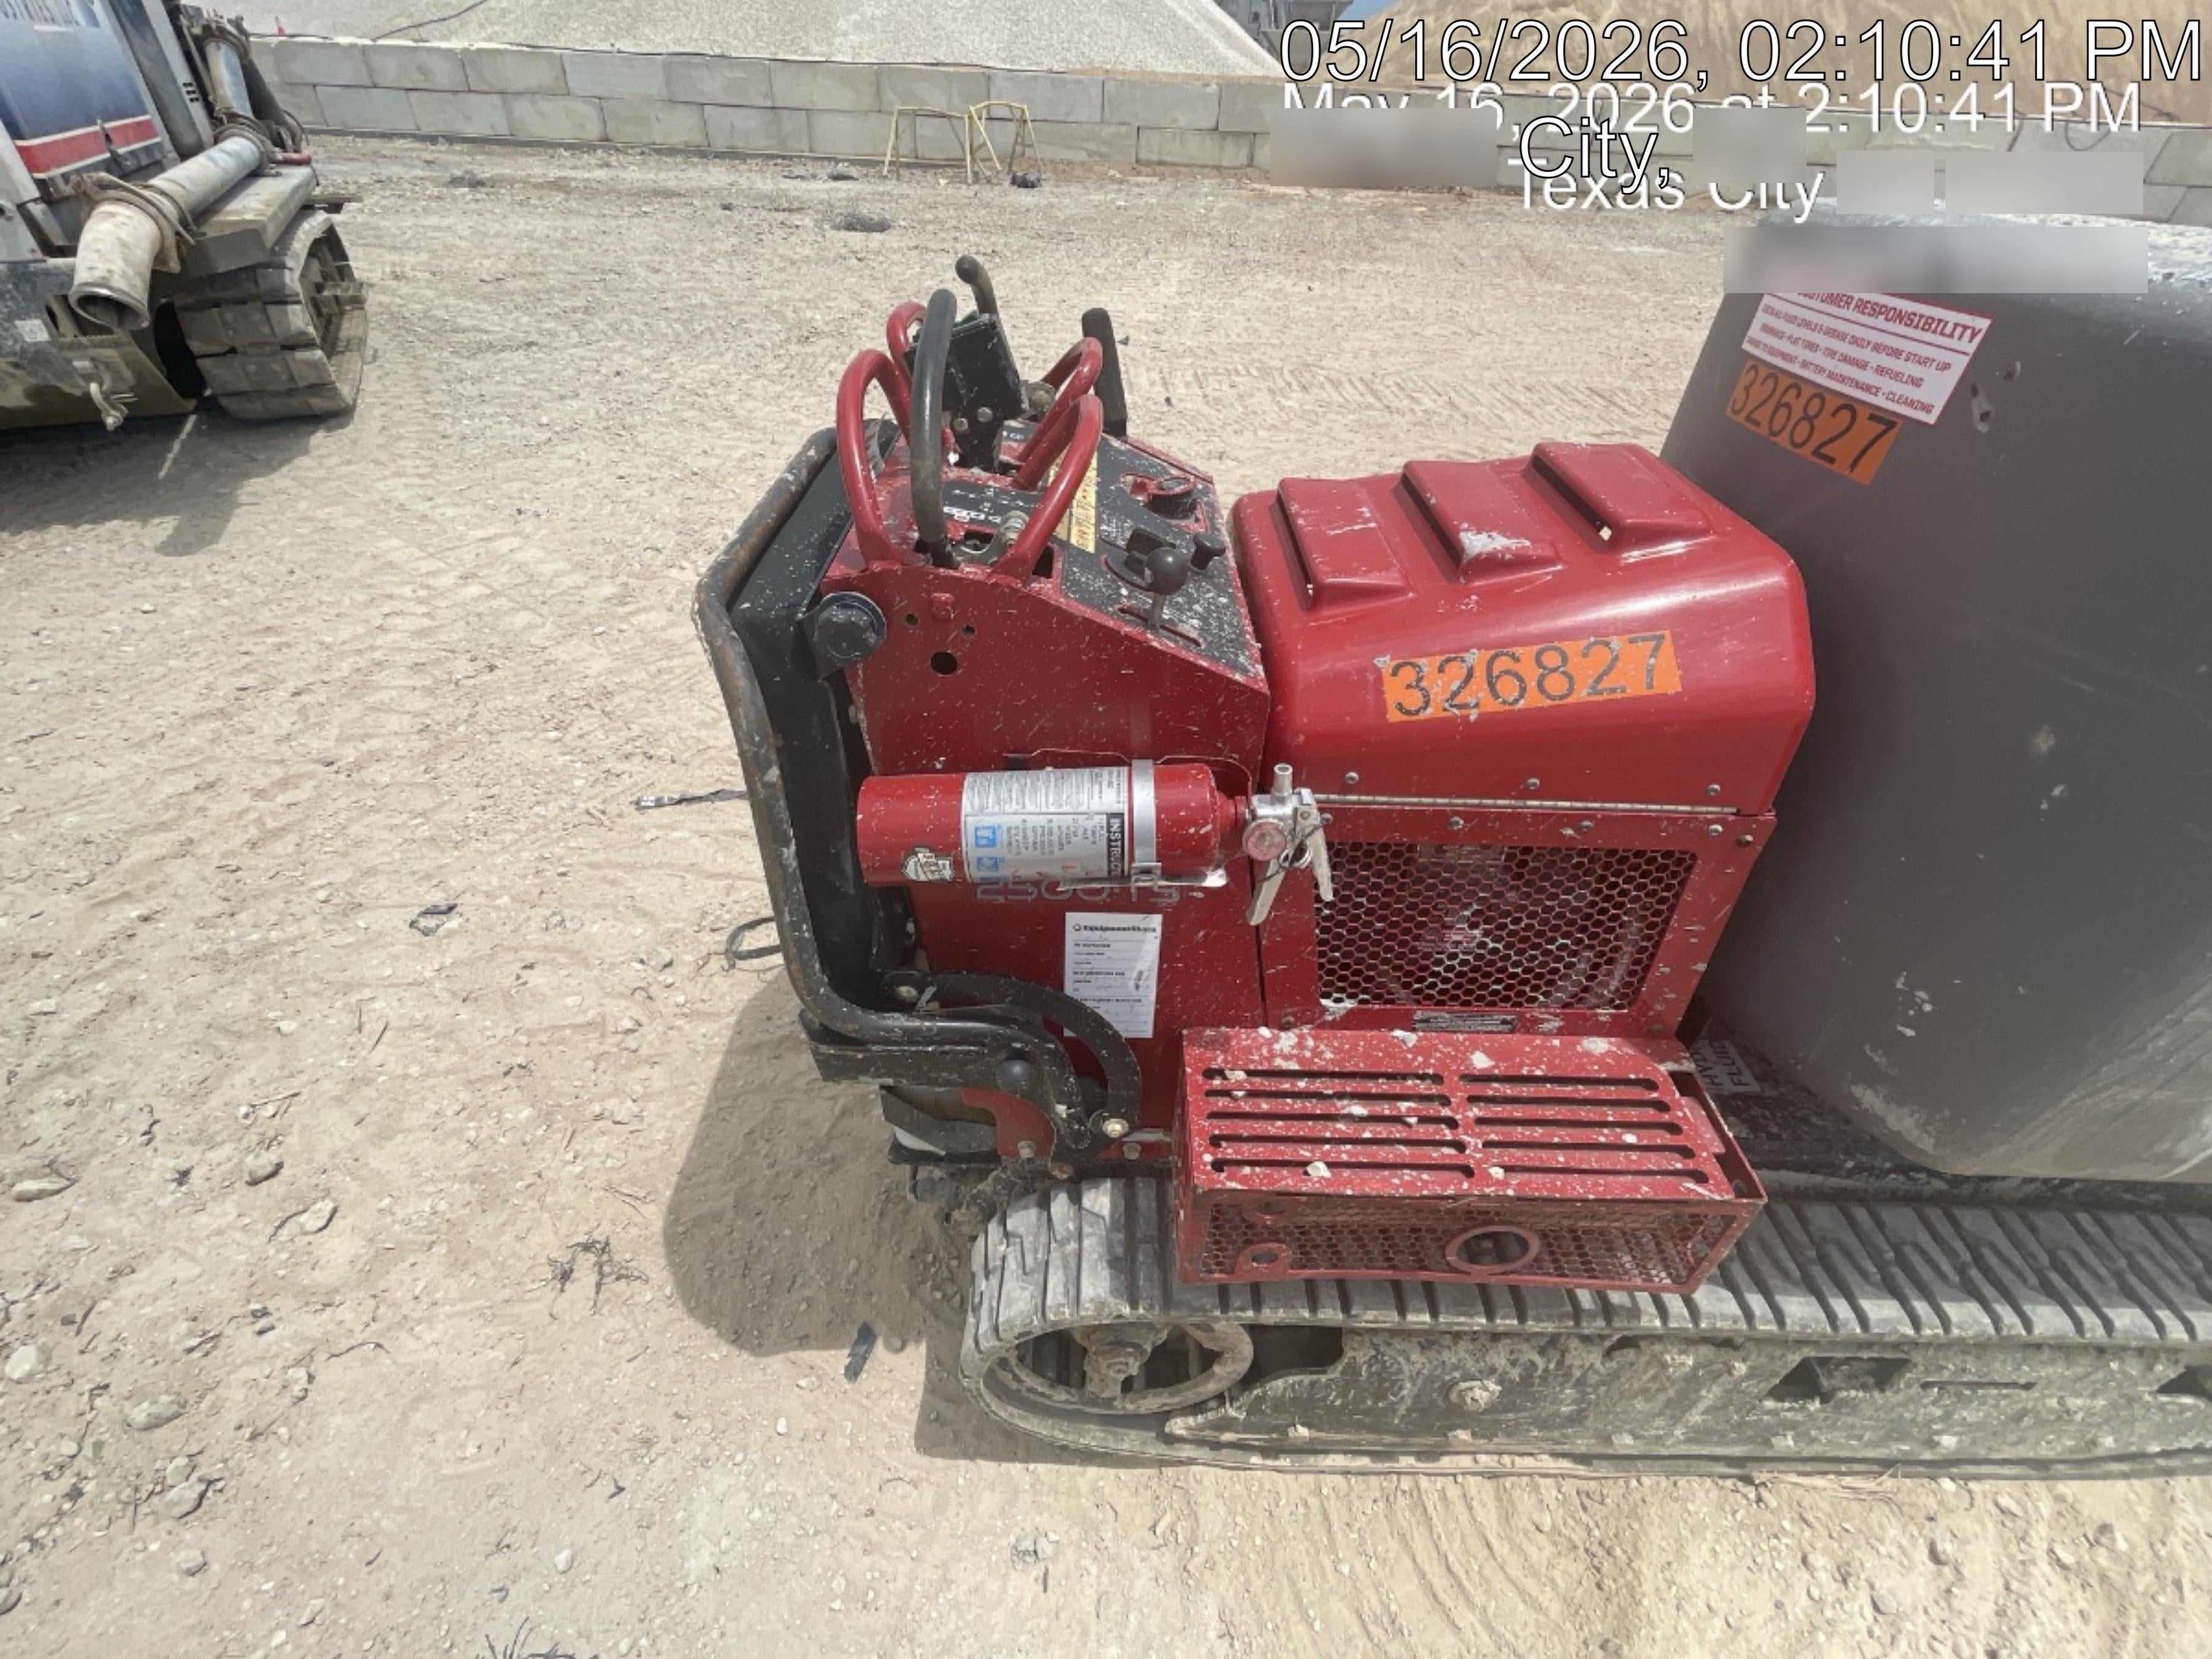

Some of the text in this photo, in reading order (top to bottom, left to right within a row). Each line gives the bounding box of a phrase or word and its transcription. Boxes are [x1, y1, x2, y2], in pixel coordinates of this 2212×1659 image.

[1852, 297, 1983, 344] RESPONSIBILITY
[1848, 335, 1872, 350] DAILY
[1871, 342, 1905, 360] BEFORE
[1904, 351, 1937, 369] START
[1935, 361, 1951, 373] UP
[1873, 364, 1924, 388] REFUELING
[1730, 363, 1898, 474] 326827
[1885, 390, 1935, 415] CLEANING
[1390, 633, 1665, 716] 326827
[1709, 1040, 1751, 1087] FLUID
